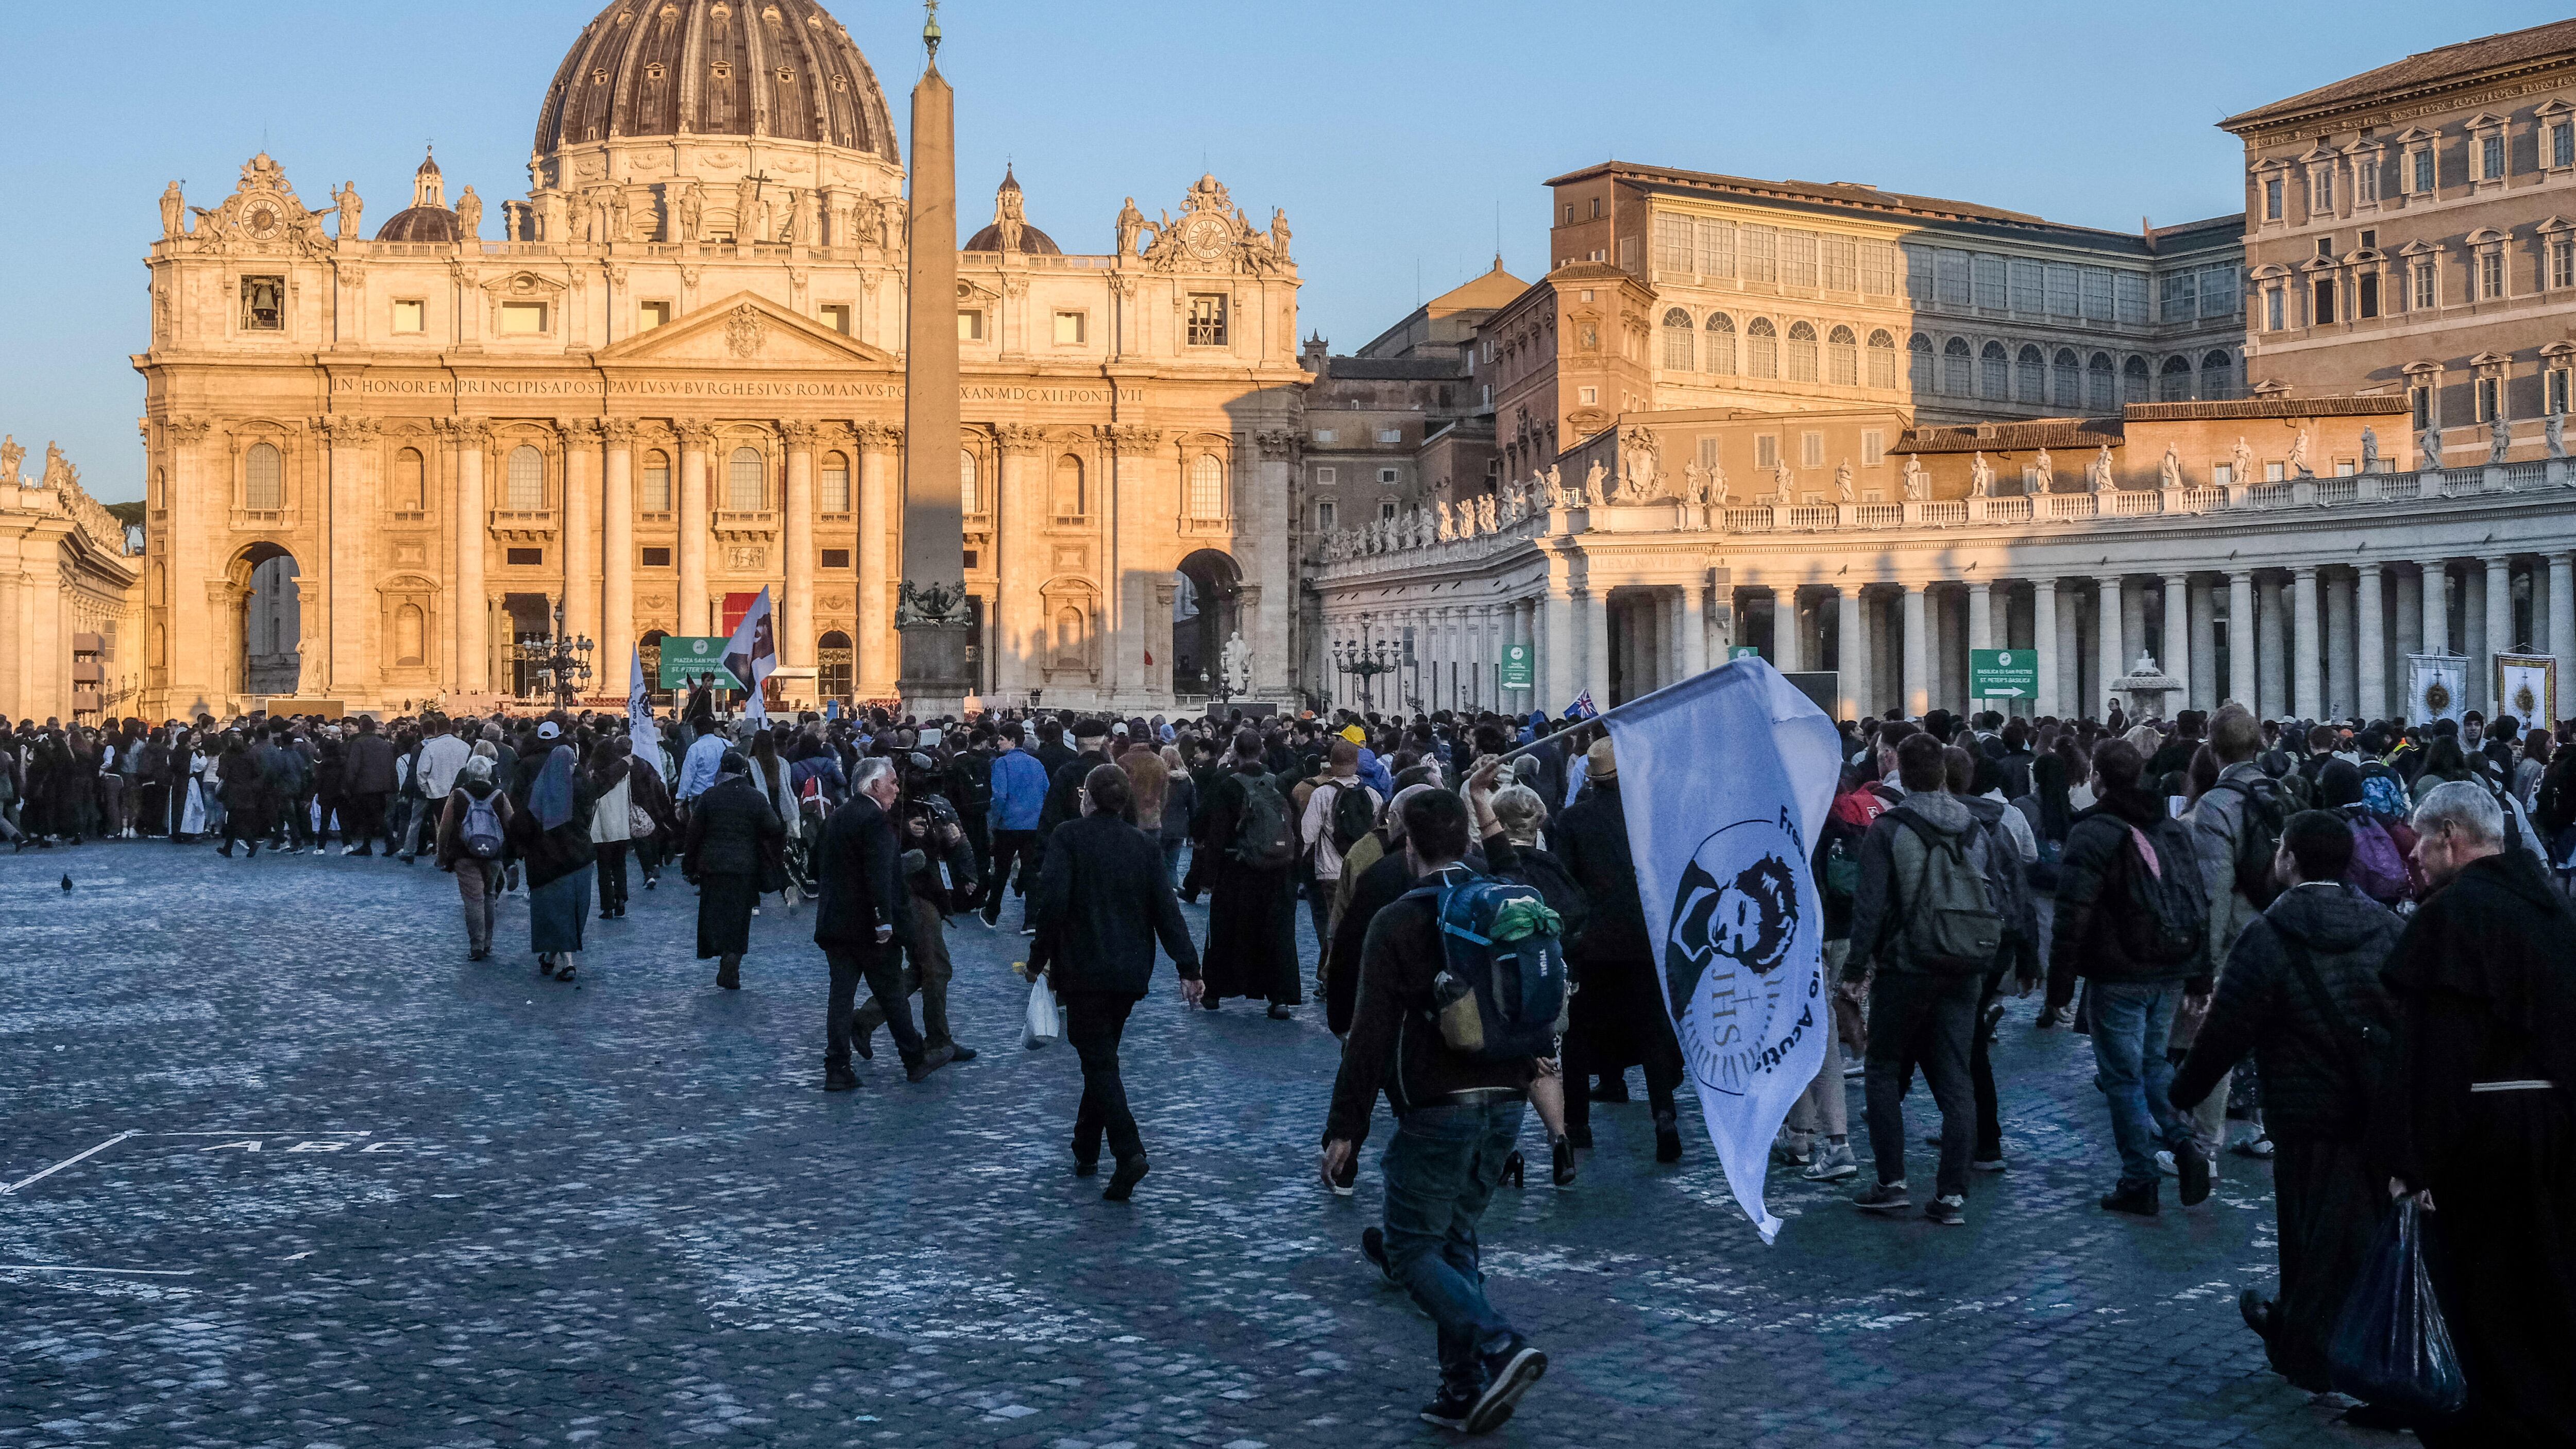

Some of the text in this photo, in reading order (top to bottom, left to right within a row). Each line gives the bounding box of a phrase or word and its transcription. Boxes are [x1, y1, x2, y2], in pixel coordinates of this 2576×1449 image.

[334, 378, 353, 391] IN
[362, 380, 452, 393] HONOREM
[458, 381, 547, 393] PRINCIPIS
[550, 381, 604, 394] APOST
[609, 381, 666, 394] PAVLVS
[685, 382, 791, 396] BVRGHESIVS
[796, 384, 883, 396] ROMANVS
[972, 387, 994, 399] AN
[998, 387, 1063, 401] MDCXII
[1069, 390, 1113, 401] PONT
[1118, 389, 1142, 401] VII
[1539, 949, 1548, 976] THULE
